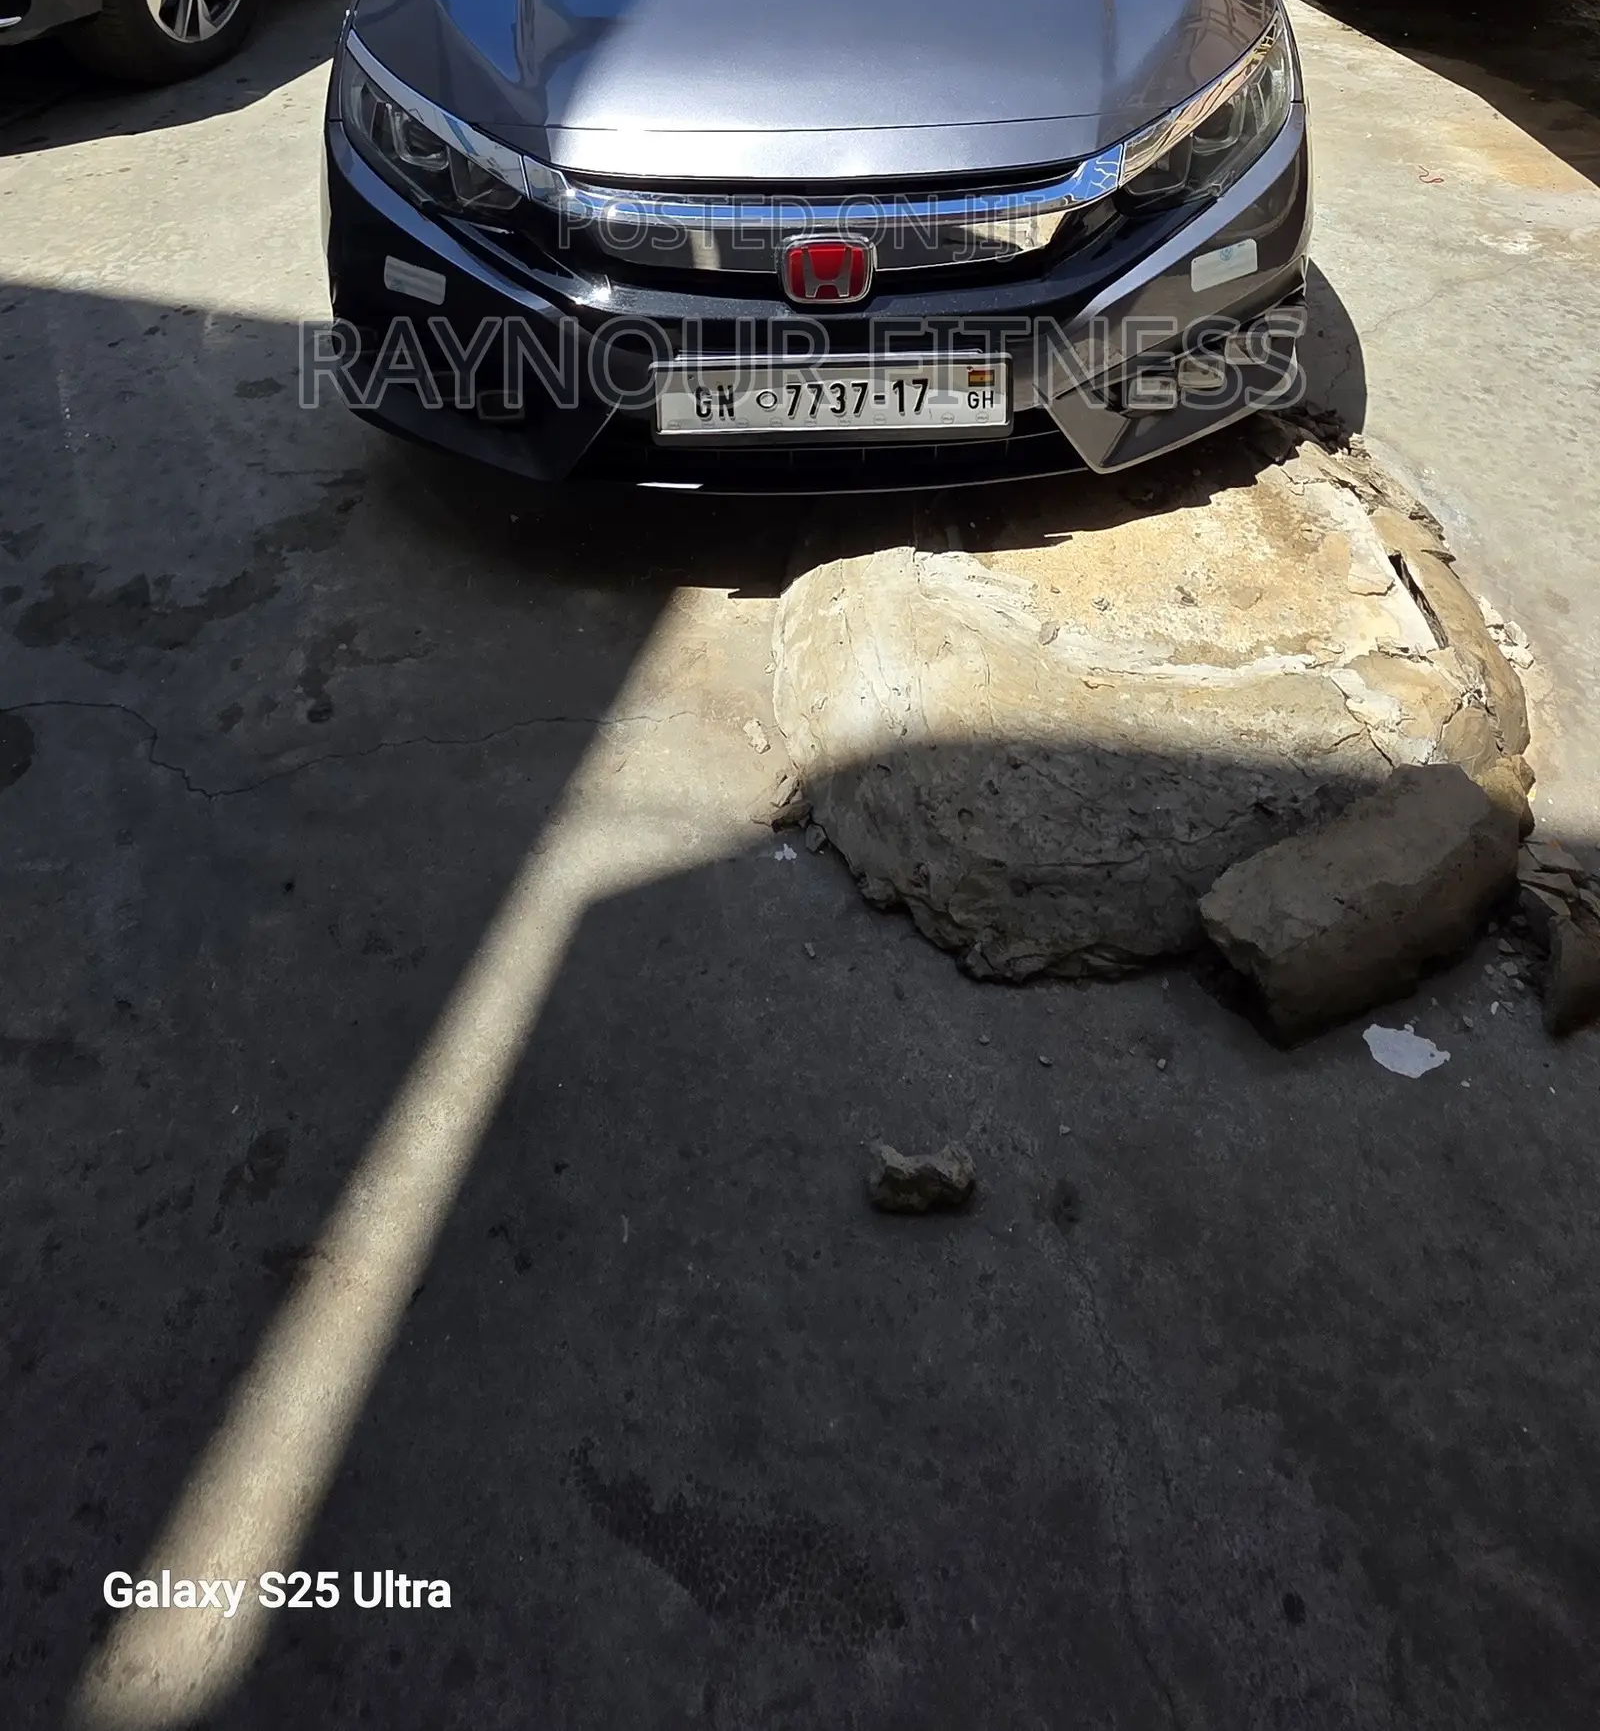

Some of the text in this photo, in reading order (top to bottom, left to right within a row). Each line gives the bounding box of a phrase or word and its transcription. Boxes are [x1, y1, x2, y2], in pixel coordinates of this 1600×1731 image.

[695, 378, 929, 419] GN 7737-17
[967, 390, 995, 410] GH
